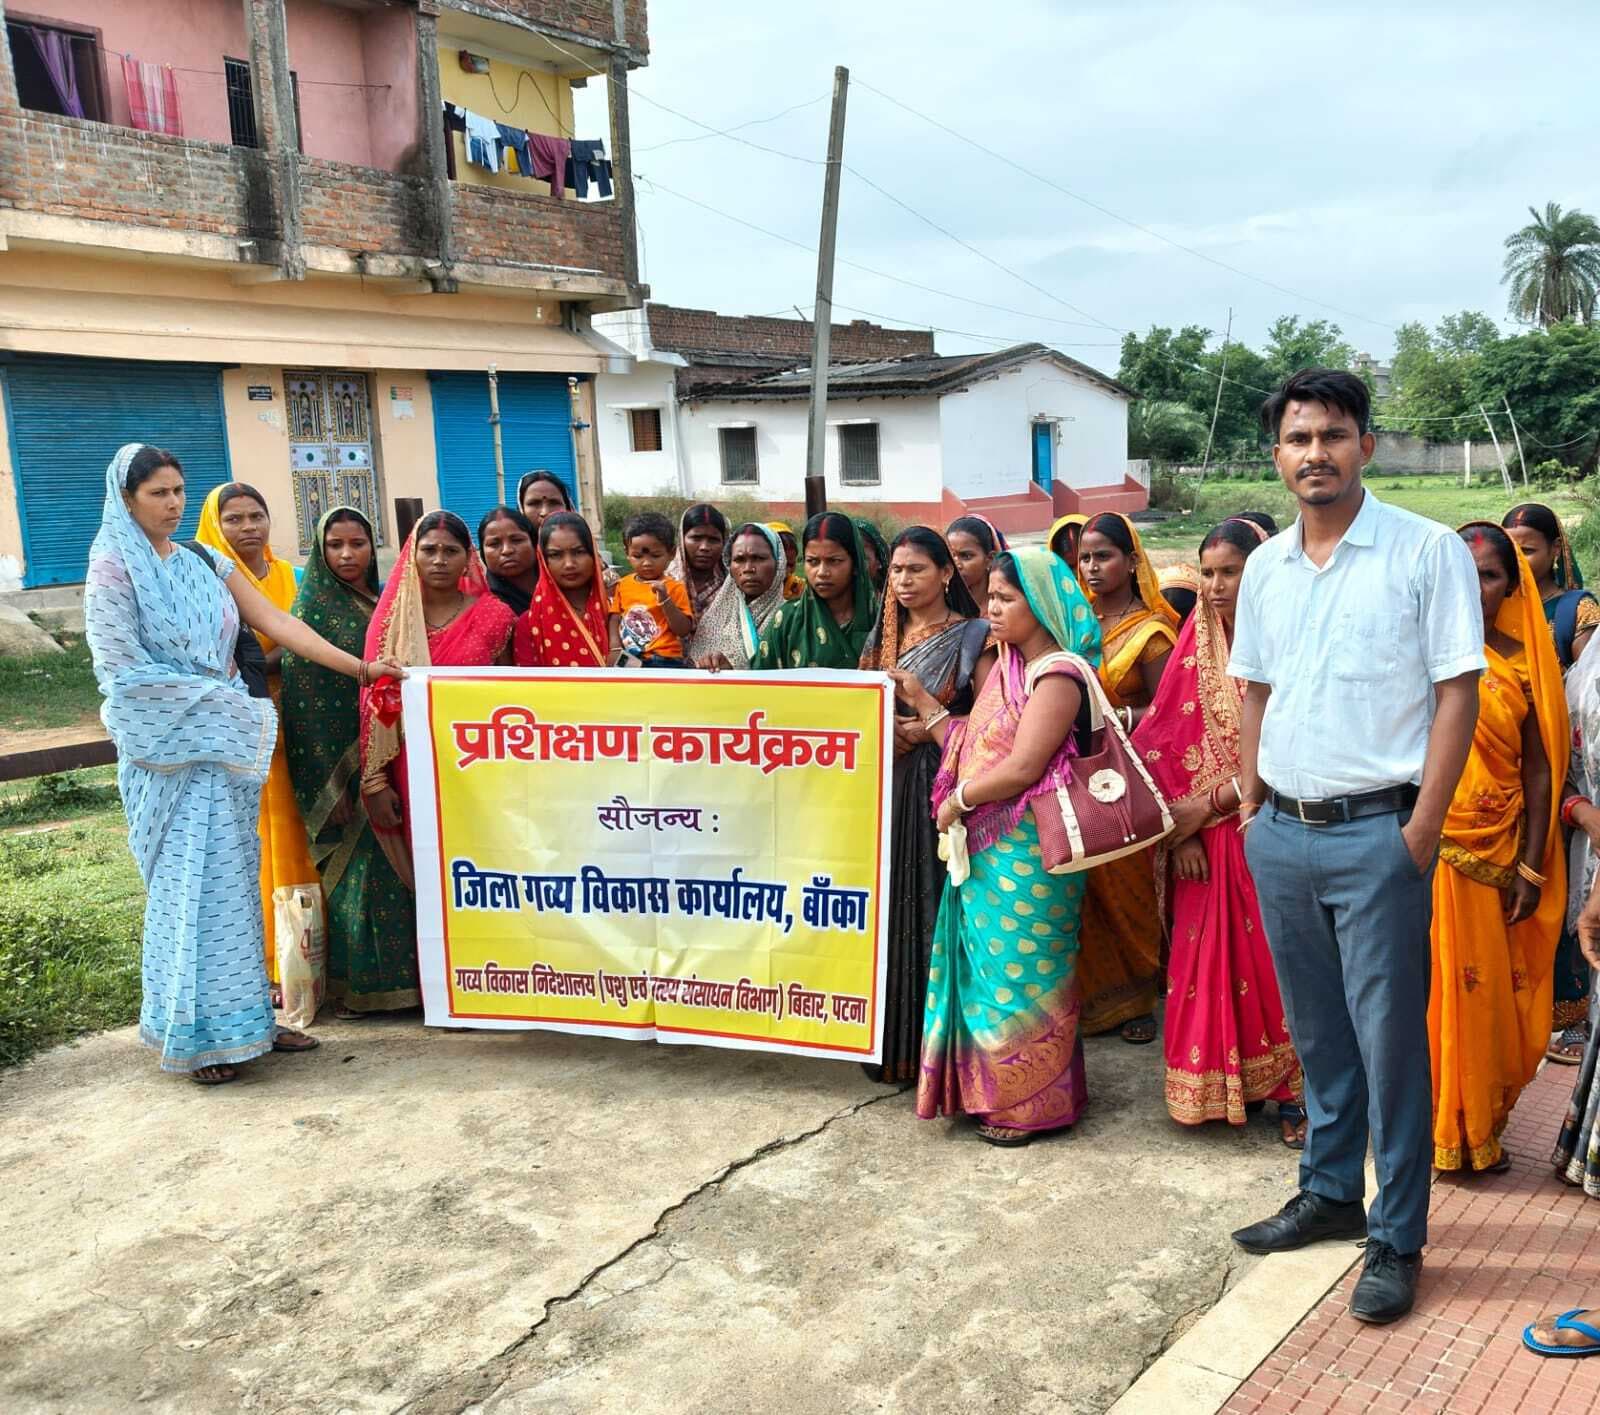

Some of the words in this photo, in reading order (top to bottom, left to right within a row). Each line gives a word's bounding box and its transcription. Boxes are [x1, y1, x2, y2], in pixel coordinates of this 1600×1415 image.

[452, 706, 642, 768] प्रशिक्षण
[650, 711, 860, 775] कार्यक्रम
[597, 796, 702, 832] सौजन्य
[452, 860, 520, 909] जिला
[522, 876, 576, 913] गव्य
[581, 866, 669, 914] विकास
[675, 867, 793, 933] कार्यालय,
[803, 876, 869, 931] बाँका
[455, 969, 482, 992] गव्य
[484, 962, 529, 993] विकास
[531, 963, 595, 997] निदेशालय
[628, 969, 649, 1000] एवं
[736, 978, 784, 1020] विभाग)
[787, 983, 828, 1024] बिहार,
[832, 995, 867, 1024] पटना
